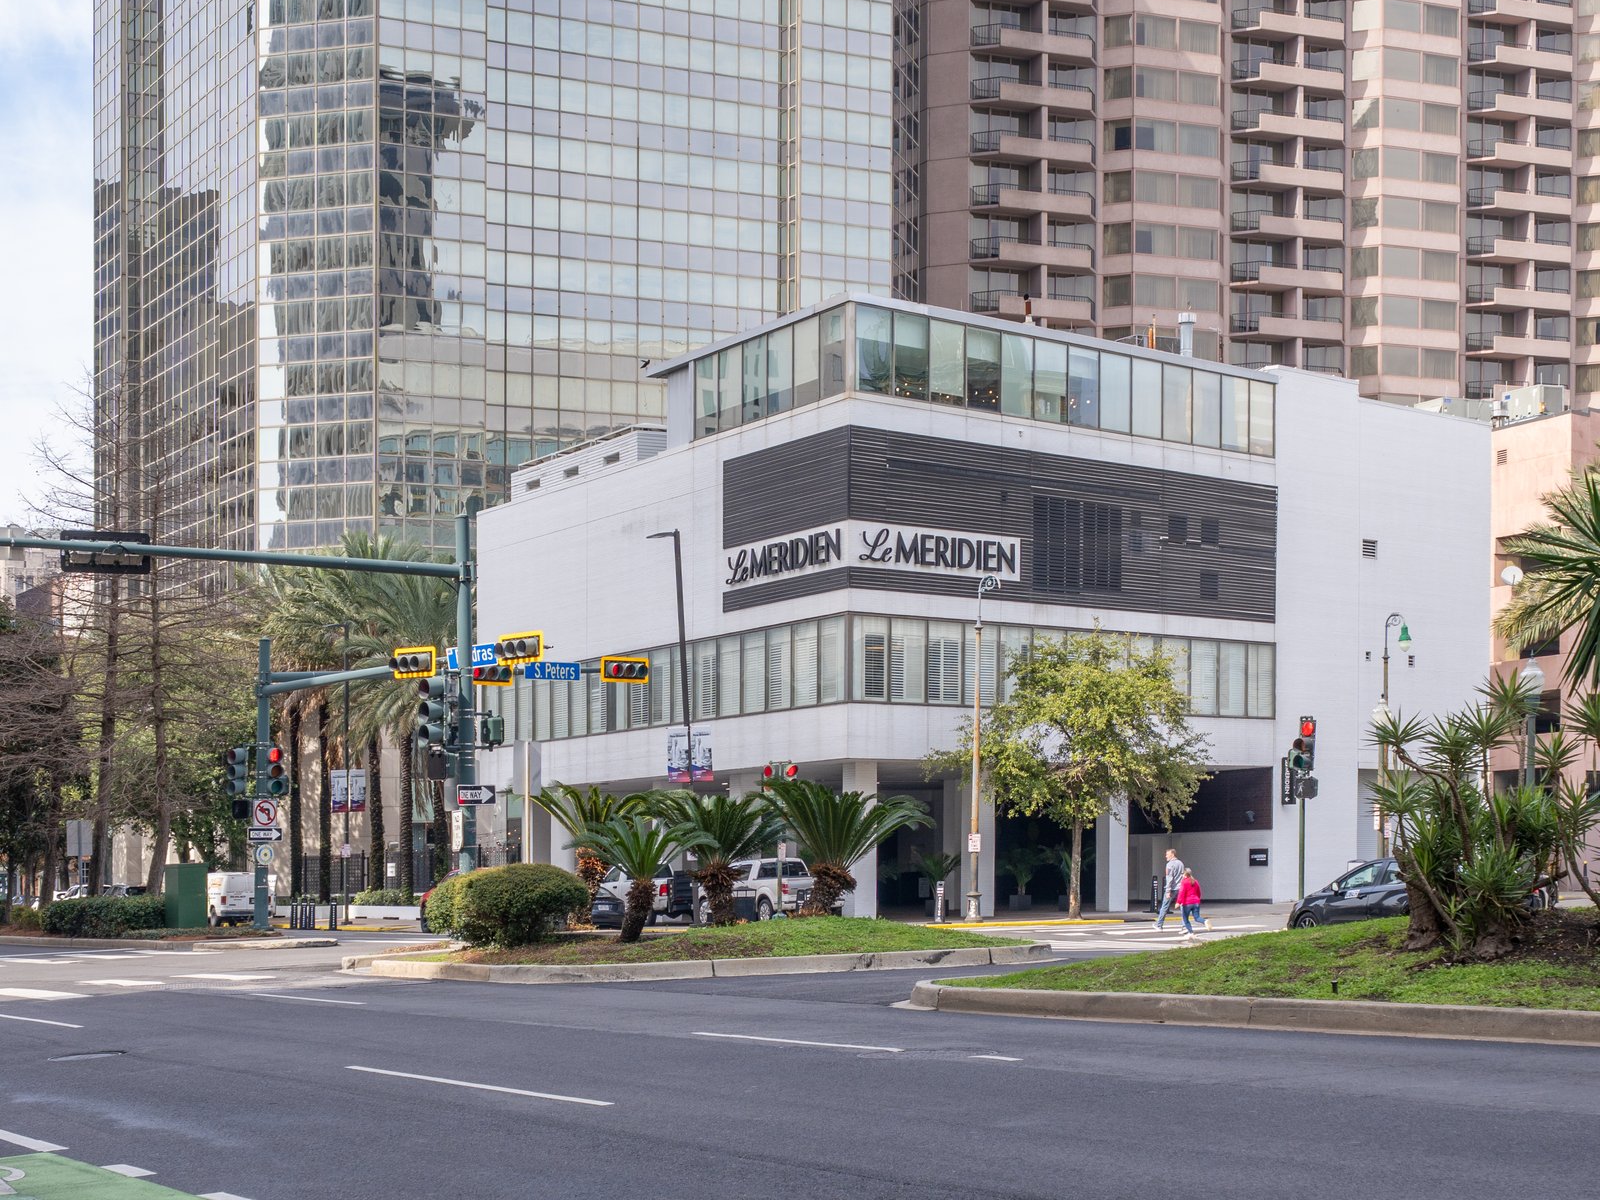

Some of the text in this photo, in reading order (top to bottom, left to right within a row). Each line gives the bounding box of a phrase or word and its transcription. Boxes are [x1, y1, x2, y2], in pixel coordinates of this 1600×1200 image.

[725, 528, 841, 585] Le MERIDIEN
[859, 528, 1016, 574] Le MERIDIEN
[455, 647, 494, 665] dras
[534, 662, 576, 680] S. Peters
[461, 791, 482, 799] ONE WAY
